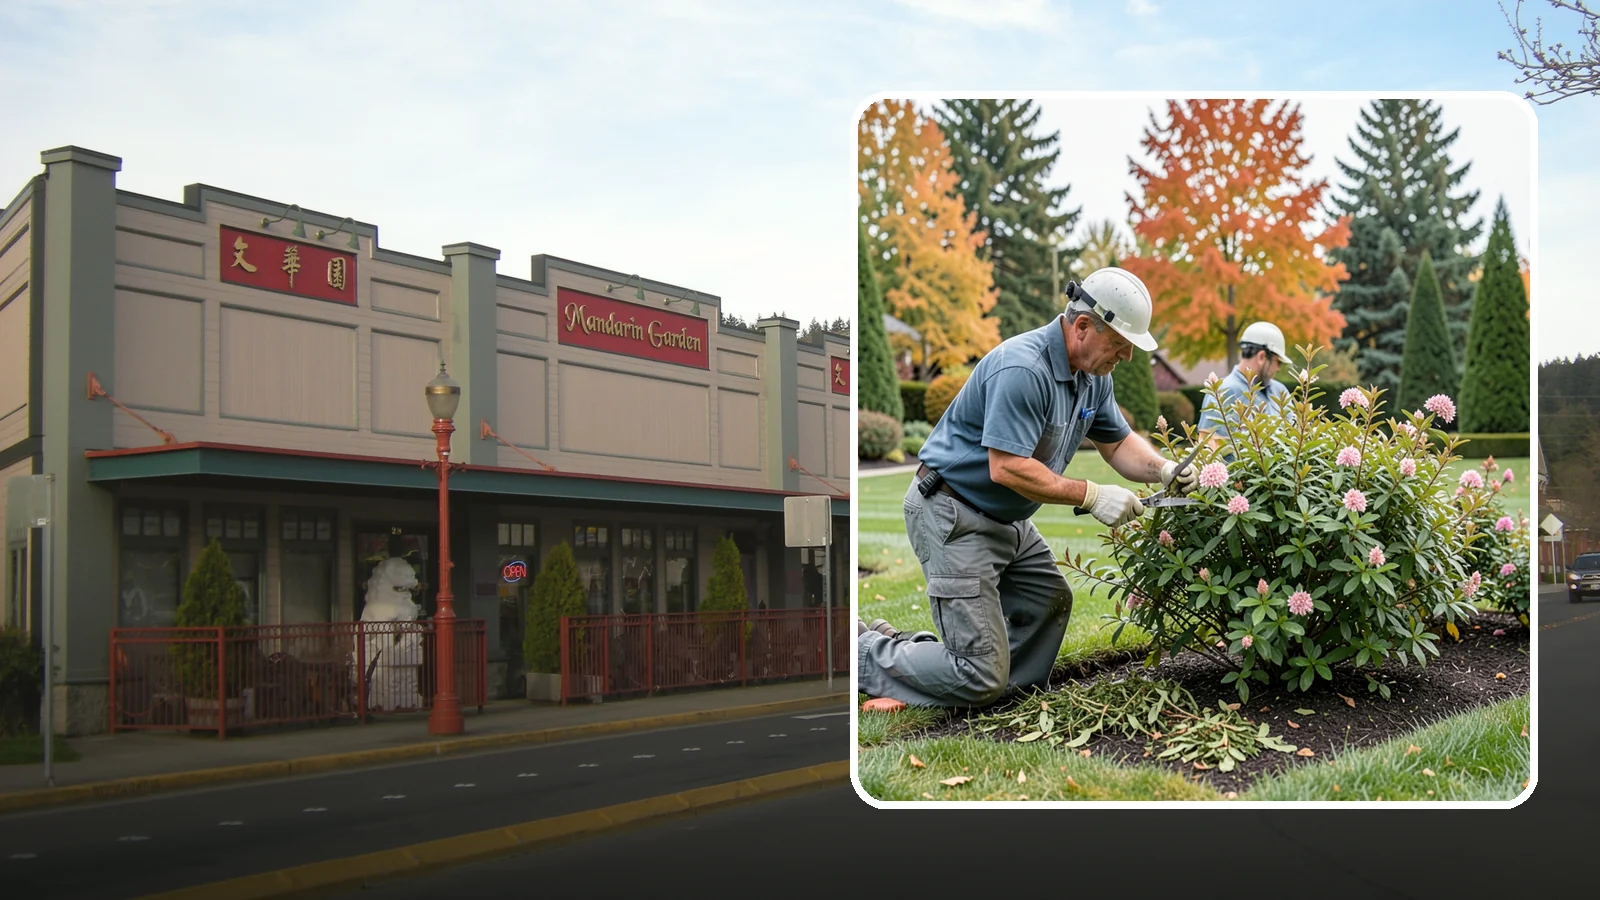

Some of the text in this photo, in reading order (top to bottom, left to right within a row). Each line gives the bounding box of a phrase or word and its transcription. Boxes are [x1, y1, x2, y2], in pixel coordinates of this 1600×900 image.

[230, 236, 346, 290] 文華園
[564, 302, 701, 352] Mandarin Garden
[503, 565, 527, 578] OPEN
